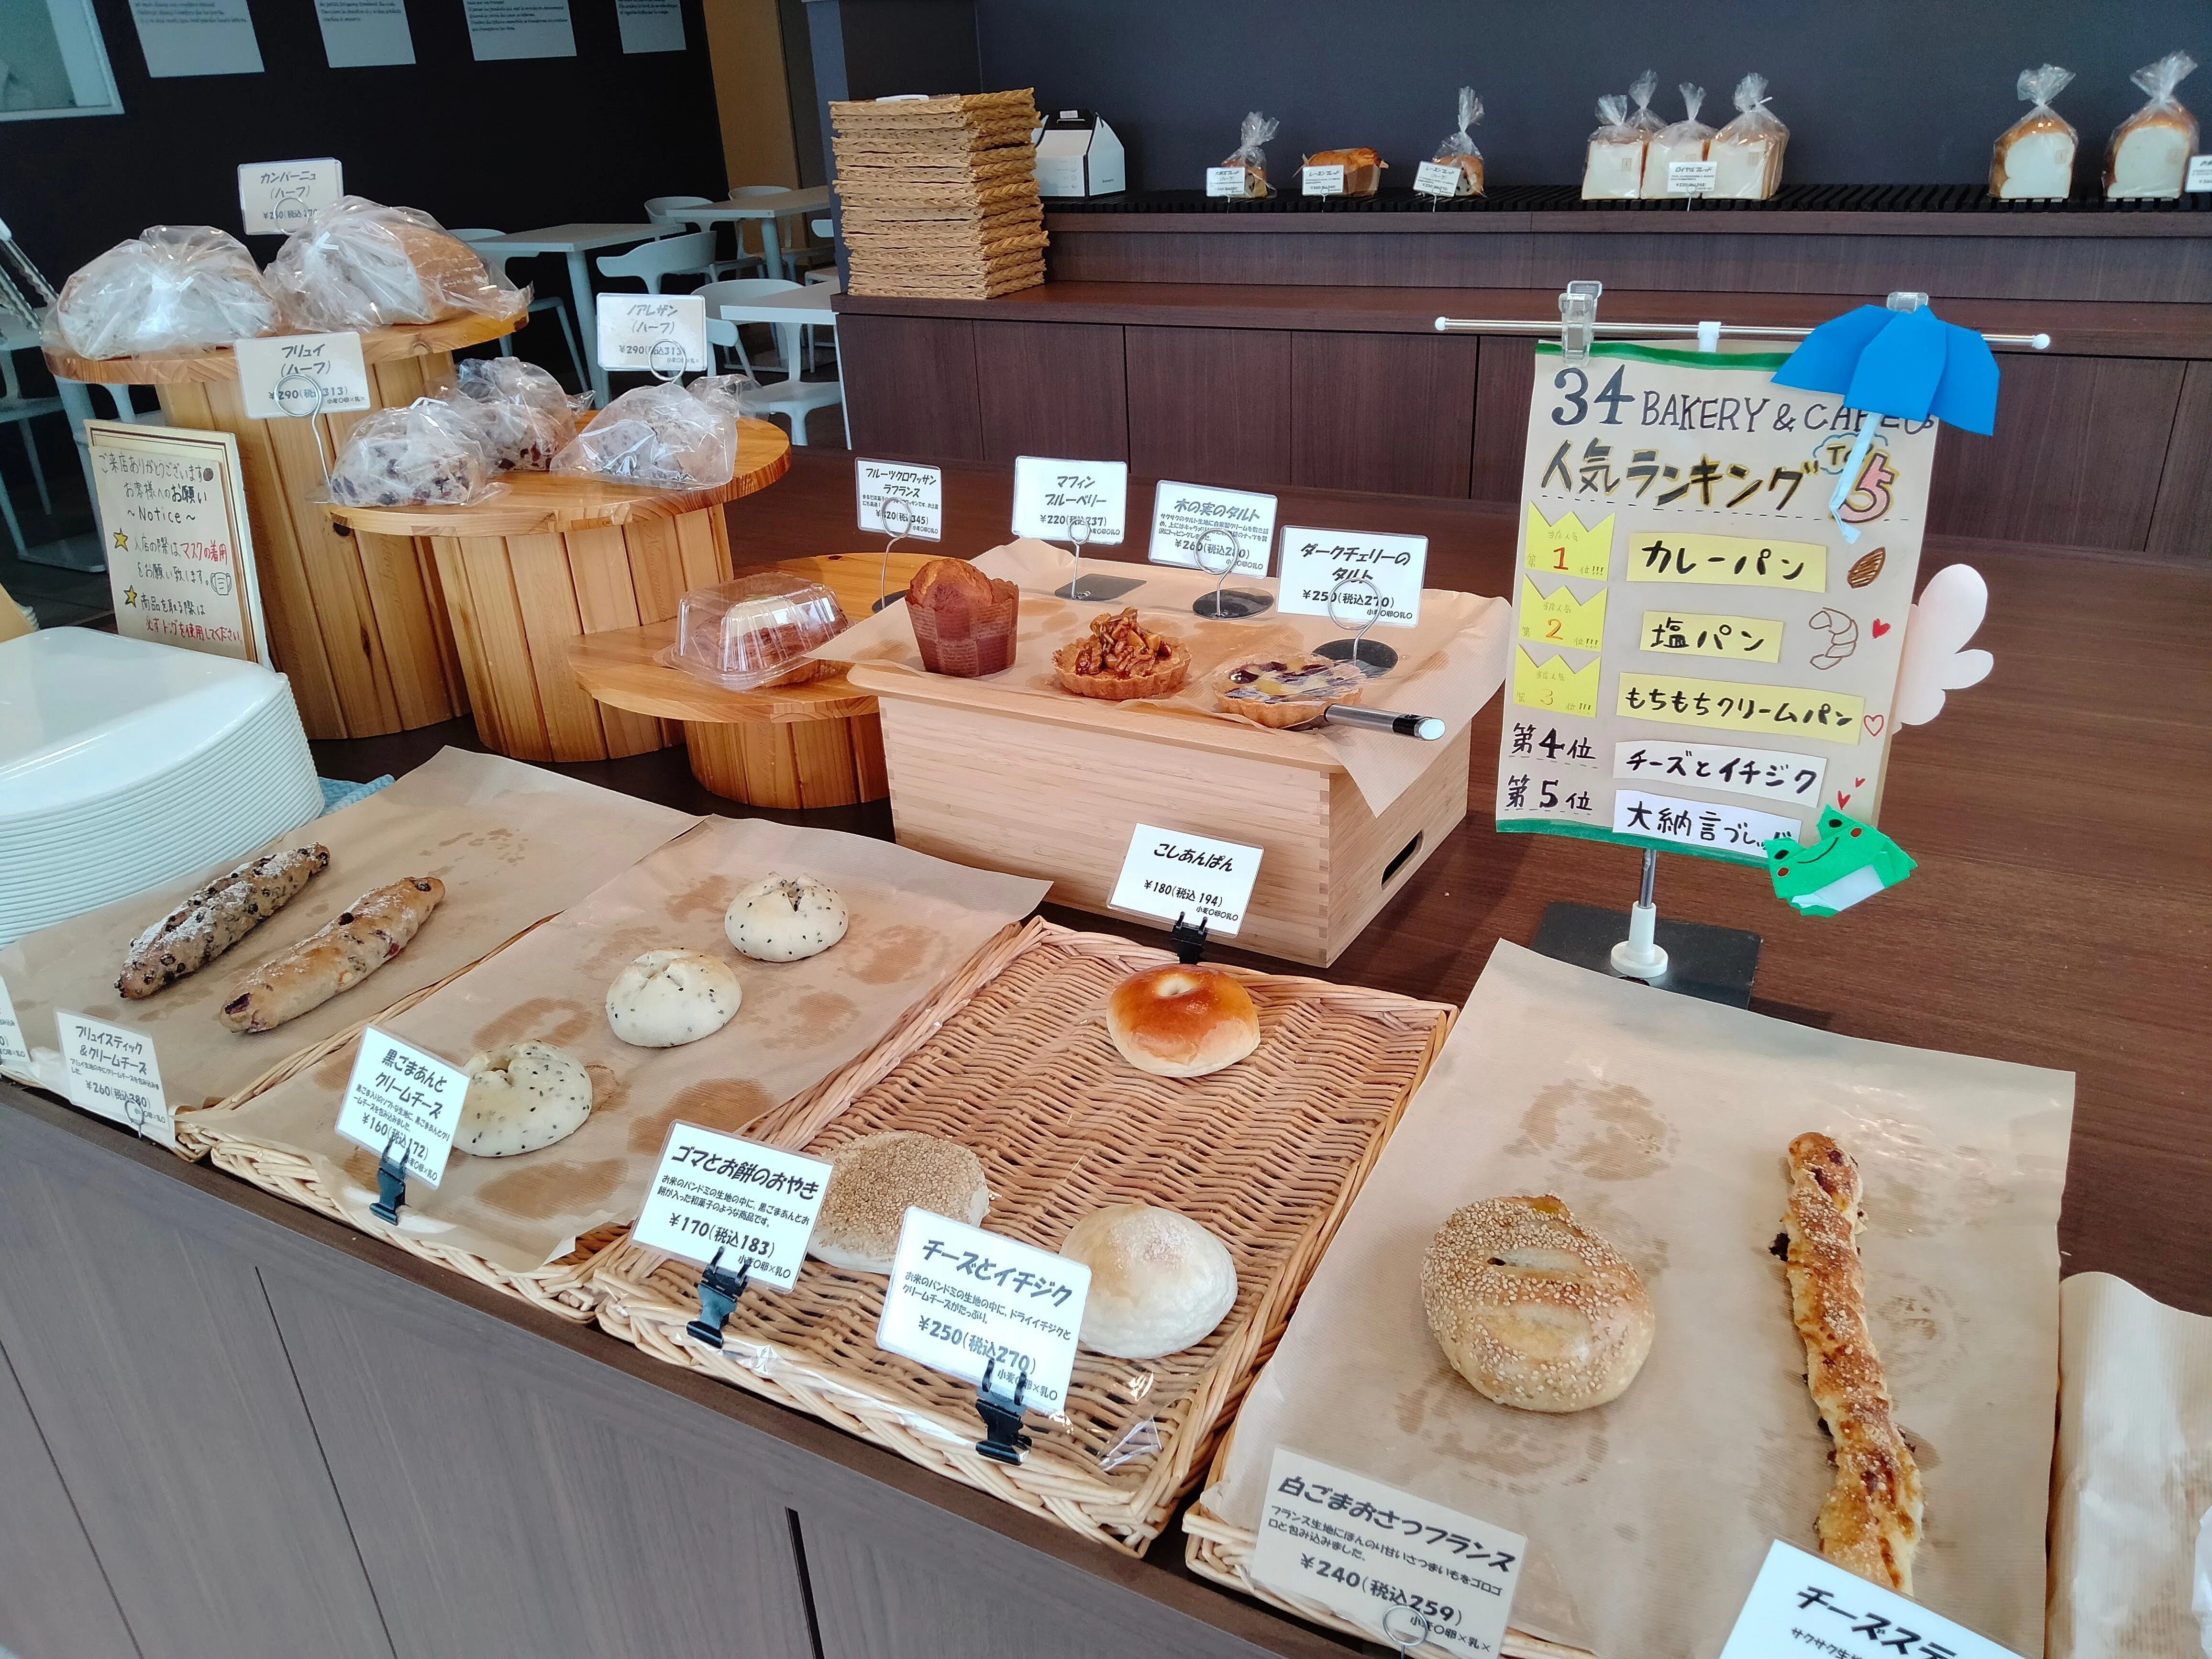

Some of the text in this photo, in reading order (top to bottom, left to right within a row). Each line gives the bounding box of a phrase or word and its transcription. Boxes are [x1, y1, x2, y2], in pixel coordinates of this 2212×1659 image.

[270, 185, 310, 199] (ハーフ)
[628, 304, 677, 317] ノアレザン
[632, 321, 675, 334] (ハーフ)
[281, 343, 325, 358] フリュイ
[281, 360, 331, 377] (ハーフ)
[1551, 364, 1636, 426] 34
[1640, 390, 1771, 433] BAKERY
[1773, 402, 1797, 432] &
[123, 480, 207, 504] お客様へのお願い
[866, 468, 936, 485] フルーツクロワッサン
[884, 484, 920, 498] ラフランス
[1057, 476, 1095, 488] マフィン
[1540, 437, 1820, 511] 人気ランキング
[1045, 494, 1106, 507] ブルーベリー
[1174, 498, 1260, 522] 木の実のタルト
[1301, 543, 1411, 566] ダークチェリーの
[1641, 540, 1804, 581] カレーパン
[1651, 616, 1765, 653] 塩パン
[1626, 686, 1853, 726] もちもちクリームパン
[1513, 721, 1597, 760] 第4位
[1626, 749, 1818, 794] チーズとイチジク
[1506, 773, 1593, 811] 第5位
[1154, 843, 1233, 872] こしあんぱん
[76, 1026, 143, 1055] フリュイスティック
[80, 1045, 147, 1075] &クリームチーズ
[382, 1048, 447, 1093] 黒ごまあんと
[375, 1072, 443, 1120] クリームチーズ
[671, 1145, 819, 1200] ゴマとお餅のおやき
[657, 1185, 770, 1228] 餅が入った和菓子のような商品です。
[662, 1174, 810, 1226] お米のパンドミの生地の中に、黒ごまあんとお
[922, 1239, 1073, 1307] チーズとイチジク
[903, 1284, 988, 1325] クリームチーズがたっぷり。
[905, 1271, 1071, 1340] お米のパンドミの生地の中に、ドライイチジクと
[1277, 1476, 1516, 1573] 白ごまおさつフランス
[1271, 1504, 1503, 1596] フランス生地にほんのり甘いさつまいもをゴロゴ
